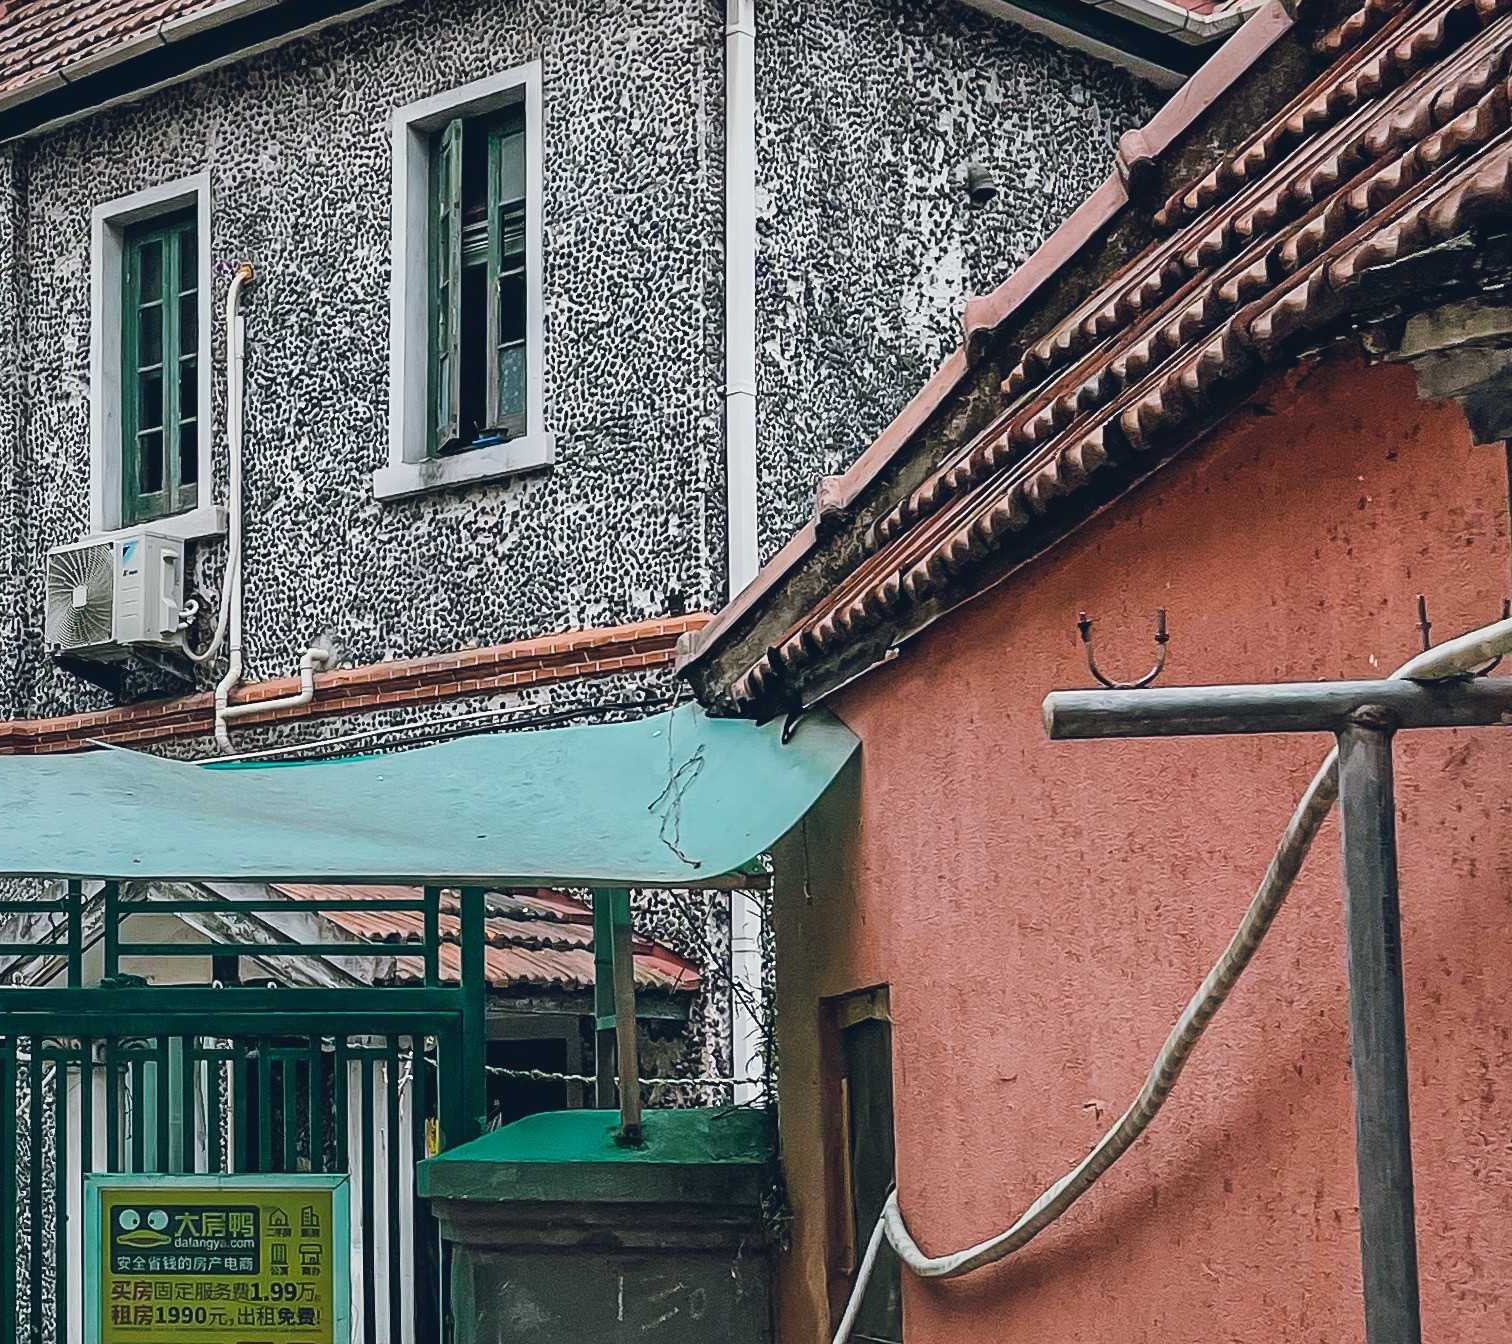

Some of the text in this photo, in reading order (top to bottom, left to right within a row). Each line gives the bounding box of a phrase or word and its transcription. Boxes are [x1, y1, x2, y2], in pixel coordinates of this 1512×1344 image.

[174, 1212, 255, 1237] 大房鸭
[175, 1237, 255, 1251] dafangya.com
[117, 1255, 254, 1272] 安全省钱的房产电商
